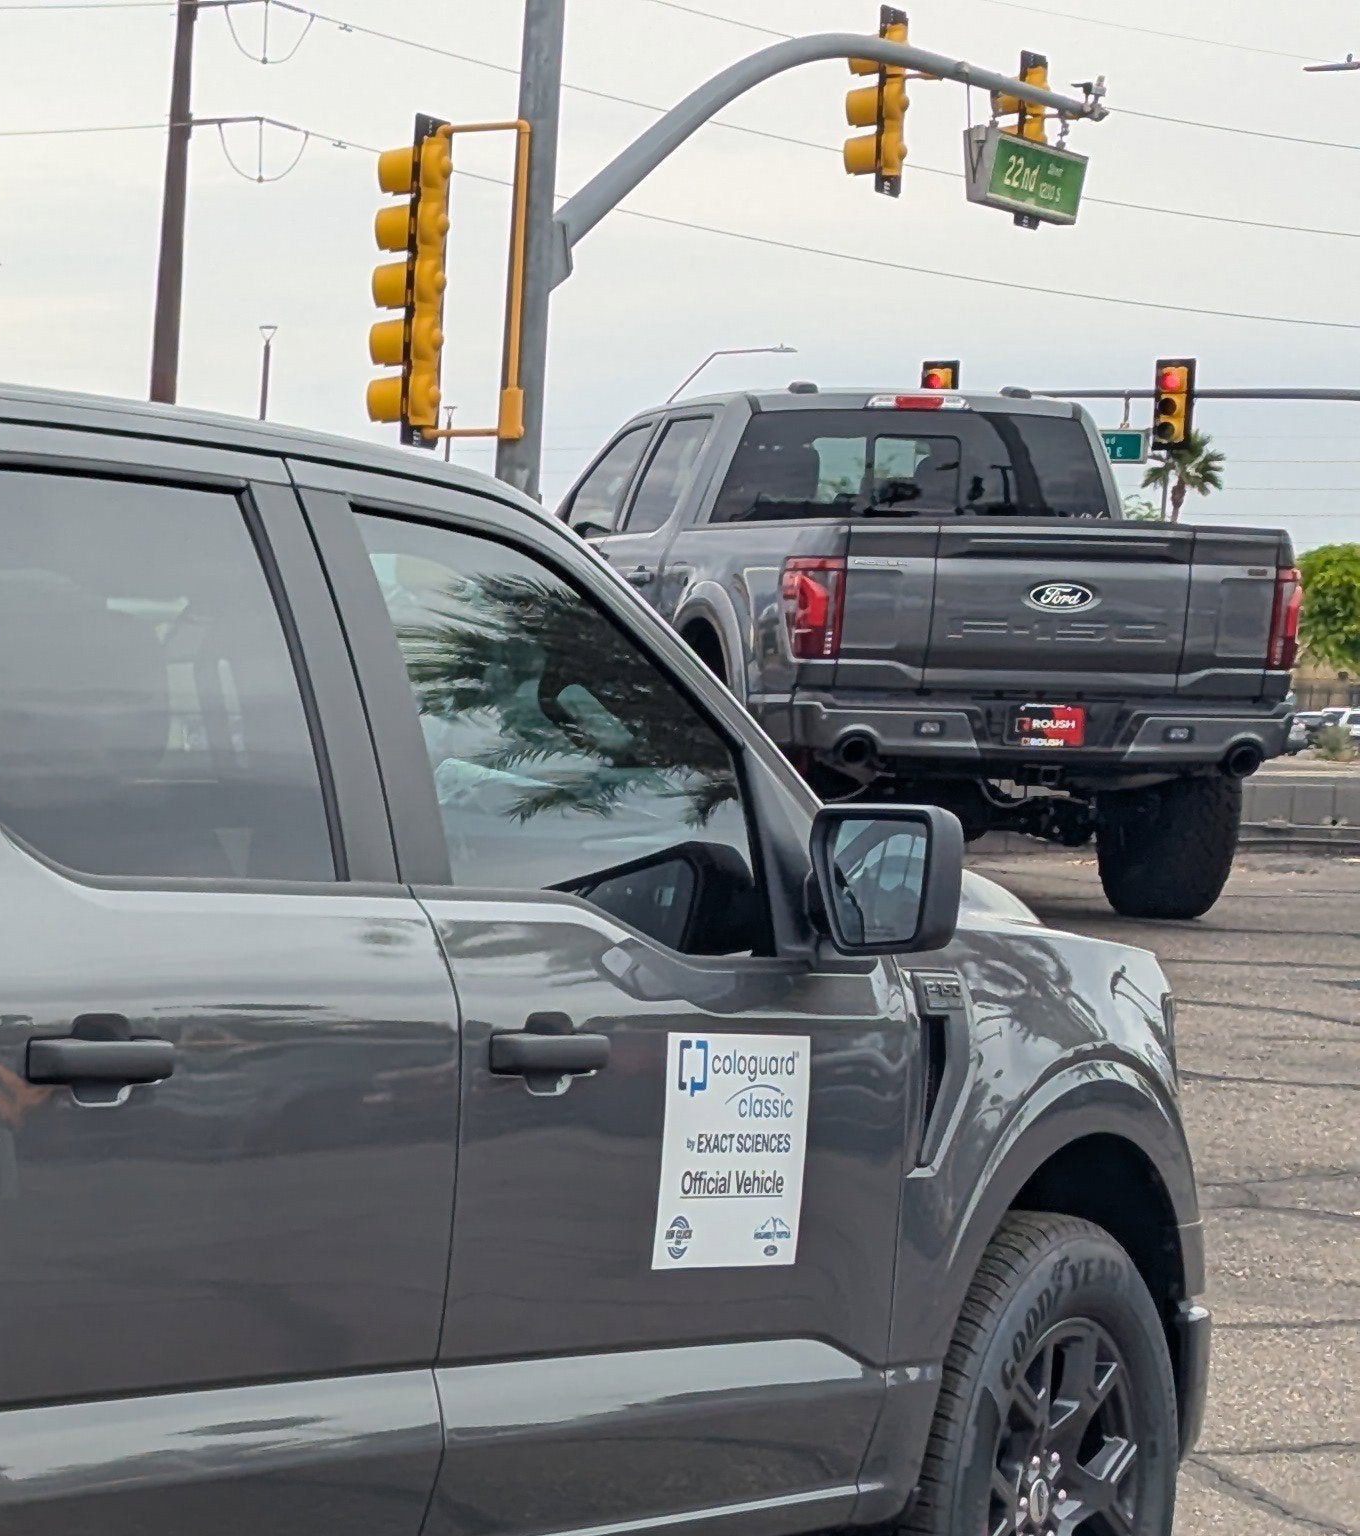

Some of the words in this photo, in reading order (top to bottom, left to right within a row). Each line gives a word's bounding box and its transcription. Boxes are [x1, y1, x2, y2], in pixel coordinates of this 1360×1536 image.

[1003, 155, 1040, 192] 22nd
[1039, 586, 1082, 606] Ford
[946, 615, 1169, 643] F-150
[1031, 718, 1076, 729] ROUSH
[738, 1092, 794, 1119] classic
[686, 1137, 696, 1151] by
[696, 1133, 736, 1154] EXACT
[736, 1133, 791, 1153] SCIENCES
[681, 1171, 731, 1195] Official
[735, 1169, 785, 1194] Vehicle
